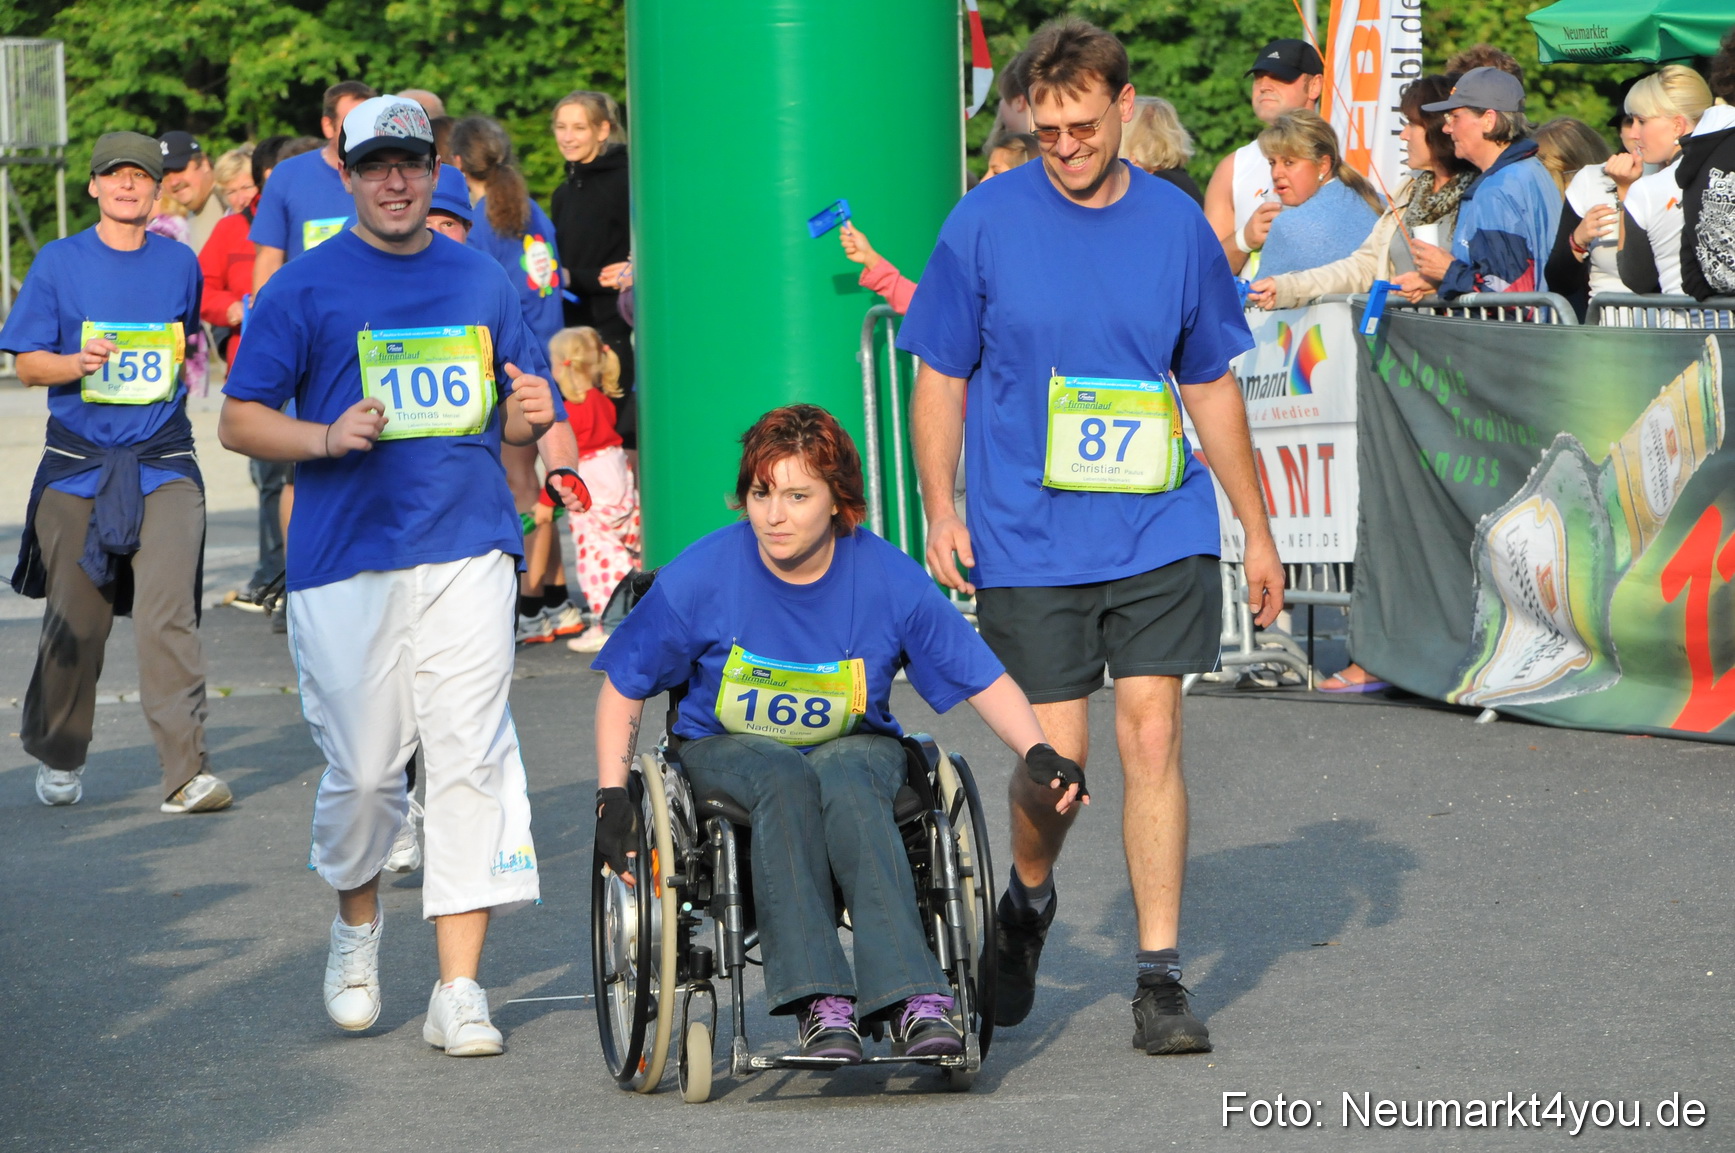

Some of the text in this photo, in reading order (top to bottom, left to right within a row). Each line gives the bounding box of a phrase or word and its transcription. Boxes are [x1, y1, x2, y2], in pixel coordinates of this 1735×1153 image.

[1562, 24, 1609, 40] Neumarkter
[378, 351, 420, 362] firmenlauf
[102, 351, 162, 383] 158
[1366, 336, 1469, 405] kologie
[380, 365, 470, 410] 106
[1068, 399, 1113, 411] firmenlauf
[1271, 405, 1320, 421] Medien
[396, 411, 439, 421] Thomas
[1078, 417, 1142, 462] 87
[1071, 462, 1121, 475] Christian
[741, 673, 788, 688] firmenlauf
[737, 688, 832, 729] 168
[746, 722, 787, 735] Nadine
